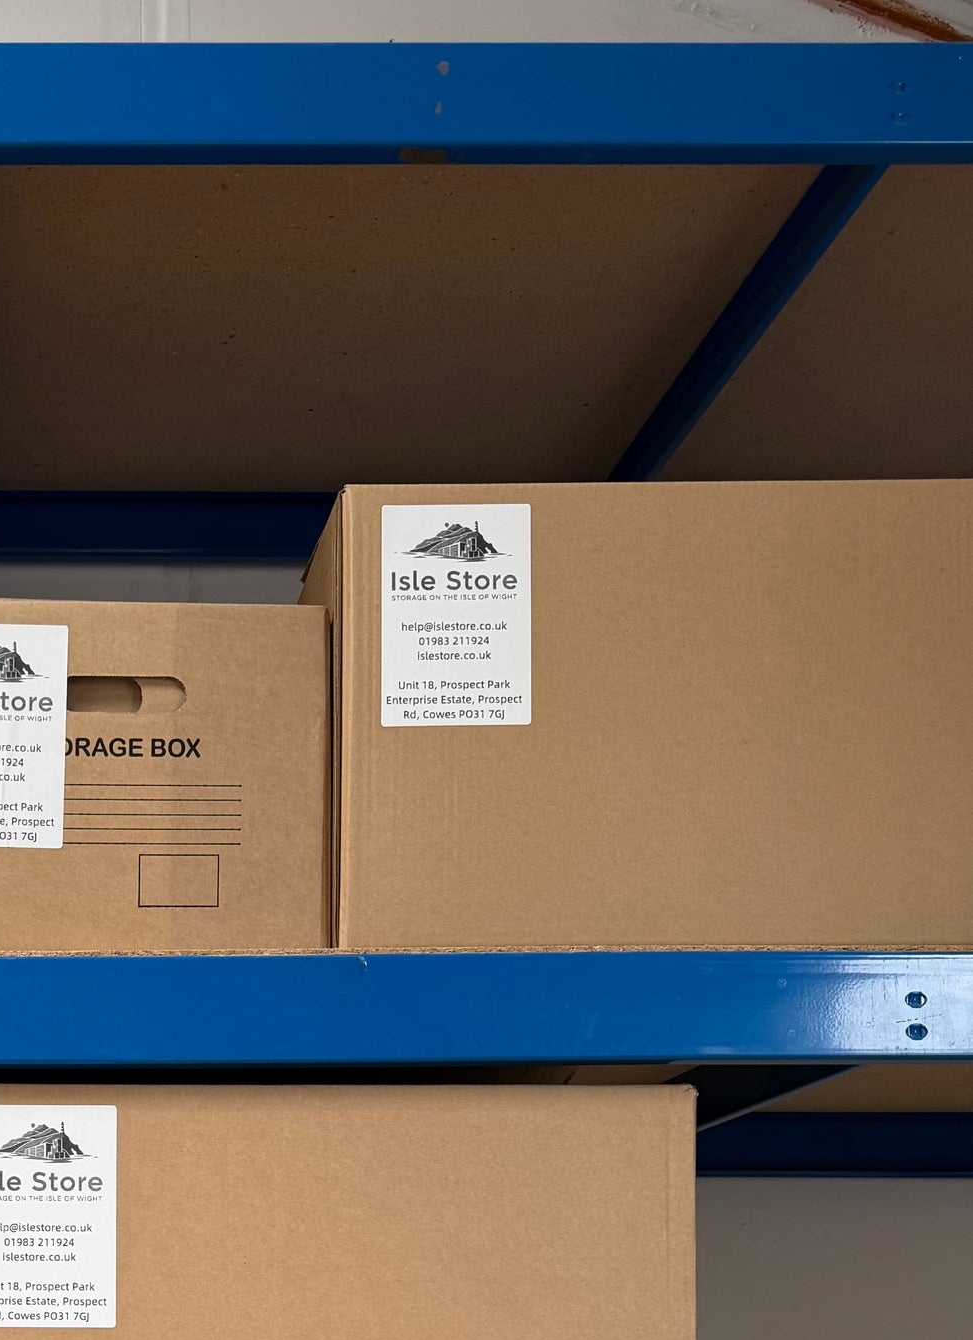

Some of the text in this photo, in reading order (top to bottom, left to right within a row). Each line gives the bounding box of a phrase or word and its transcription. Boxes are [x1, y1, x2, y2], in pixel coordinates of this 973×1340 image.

[391, 570, 517, 591] Isle Store
[402, 621, 507, 633] help@islestore.co.uk
[419, 636, 489, 645] 01983 211924
[417, 651, 491, 660] islestore.co.uk
[399, 680, 510, 691] Unit 18, Prospect Park
[387, 695, 522, 706] Enterprise Estate, Prospect
[404, 710, 504, 720] Rd, Cowes PO31 7GJ
[150, 738, 200, 758] BOX
[21, 803, 43, 811] Park
[12, 817, 54, 828] Prospect
[22, 832, 37, 842] 7GJ
[32, 1172, 103, 1192] Store
[4, 1238, 74, 1247] 01983 211924
[3, 1252, 76, 1261] islestore.co.uk
[8, 1282, 22, 1292] 18,
[26, 1282, 69, 1292] Prospect
[73, 1282, 95, 1291] Park
[26, 1297, 59, 1307] Estate,
[63, 1297, 107, 1308] Prospect
[8, 1311, 40, 1320] Cowes
[44, 1312, 68, 1320] PO31
[74, 1312, 89, 1322] 7GJ
